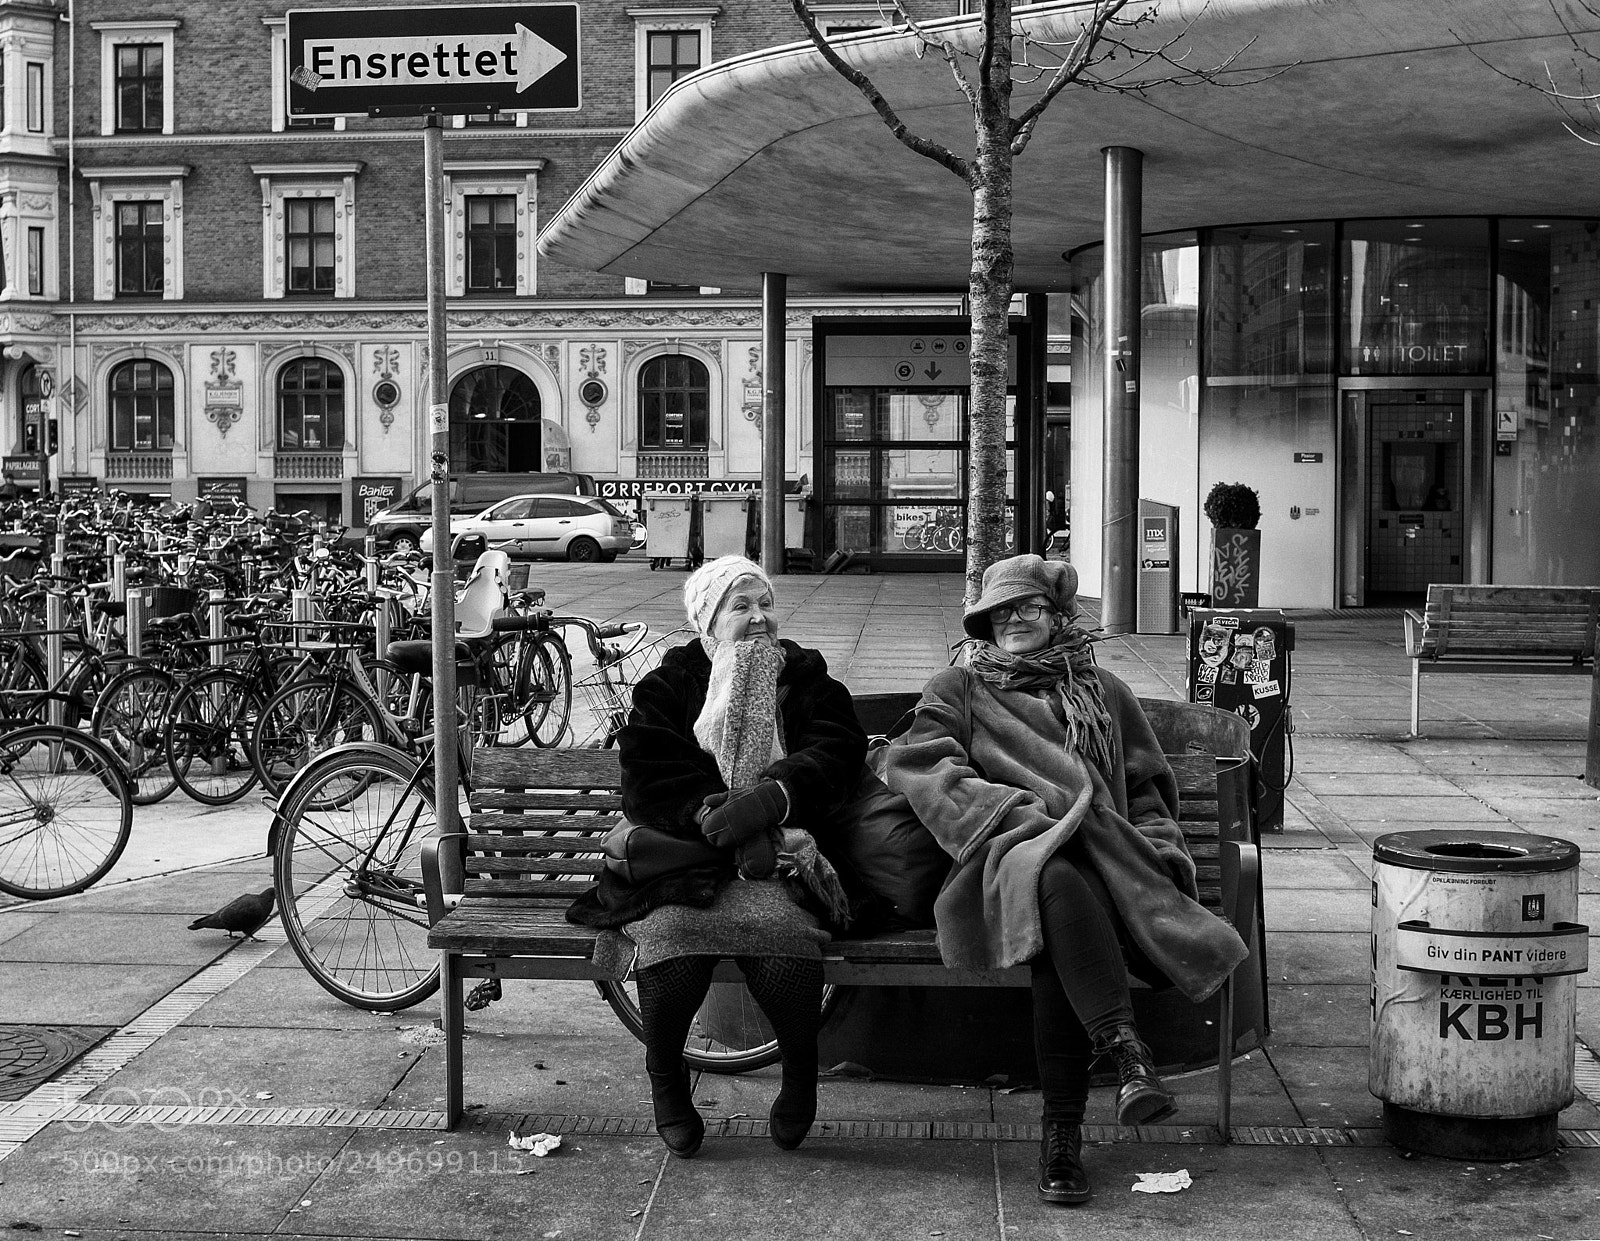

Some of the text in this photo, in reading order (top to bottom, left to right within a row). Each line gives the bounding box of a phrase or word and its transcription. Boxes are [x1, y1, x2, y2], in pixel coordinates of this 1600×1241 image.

[312, 41, 519, 80] Ensrettet
[1398, 345, 1467, 362] TOILET
[359, 485, 395, 497] Bantex
[896, 513, 924, 521] bikes
[1146, 529, 1164, 537] mx
[1254, 684, 1278, 695] KUSSE
[1427, 945, 1567, 963] Giv din PANT videre
[1440, 988, 1543, 1001] KÆRLIGHED TIL
[1439, 1002, 1543, 1041] KBH
